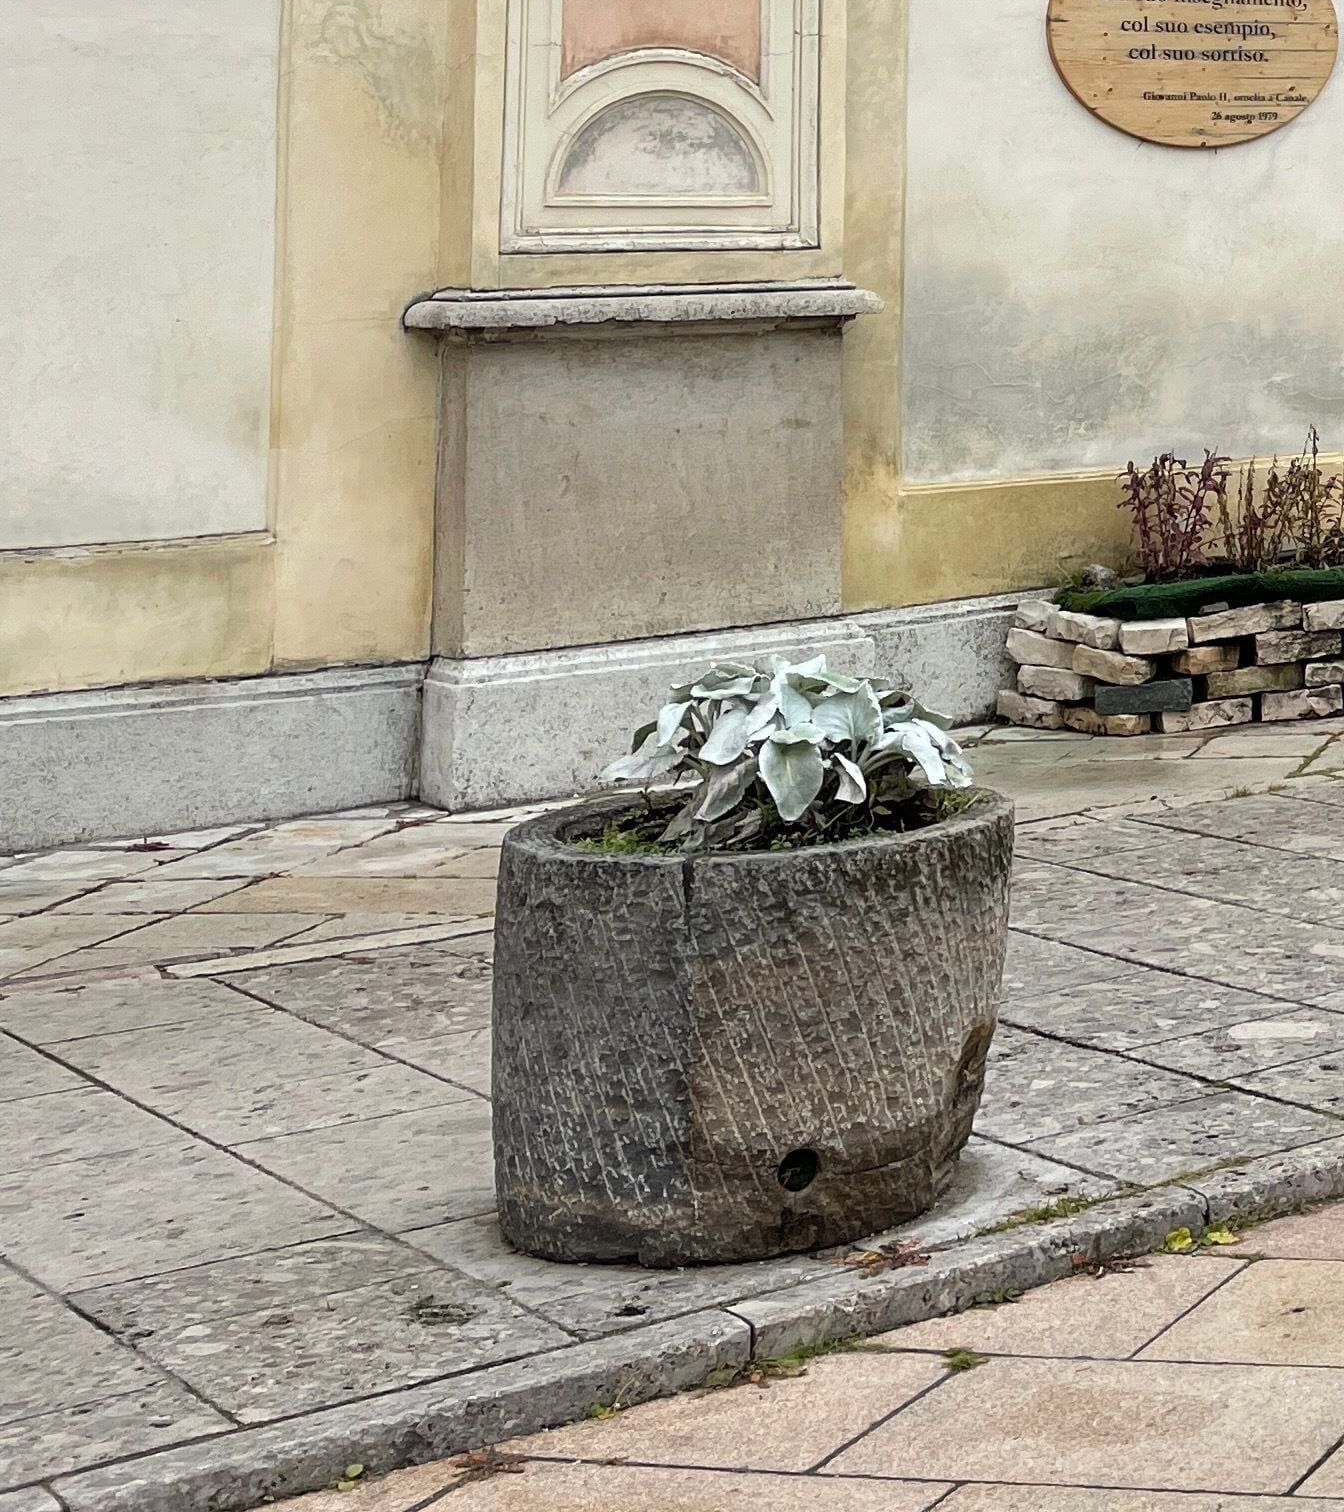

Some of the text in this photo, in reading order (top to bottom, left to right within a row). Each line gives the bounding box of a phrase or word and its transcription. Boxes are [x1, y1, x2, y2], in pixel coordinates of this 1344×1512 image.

[1120, 16, 1276, 40] col suo esempio,
[1128, 44, 1269, 63] col suo sorriso.
[1143, 91, 1187, 102] Giovanni
[1190, 92, 1217, 101] Paolo
[1211, 112, 1222, 121] 26
[1224, 113, 1256, 123] agosto
